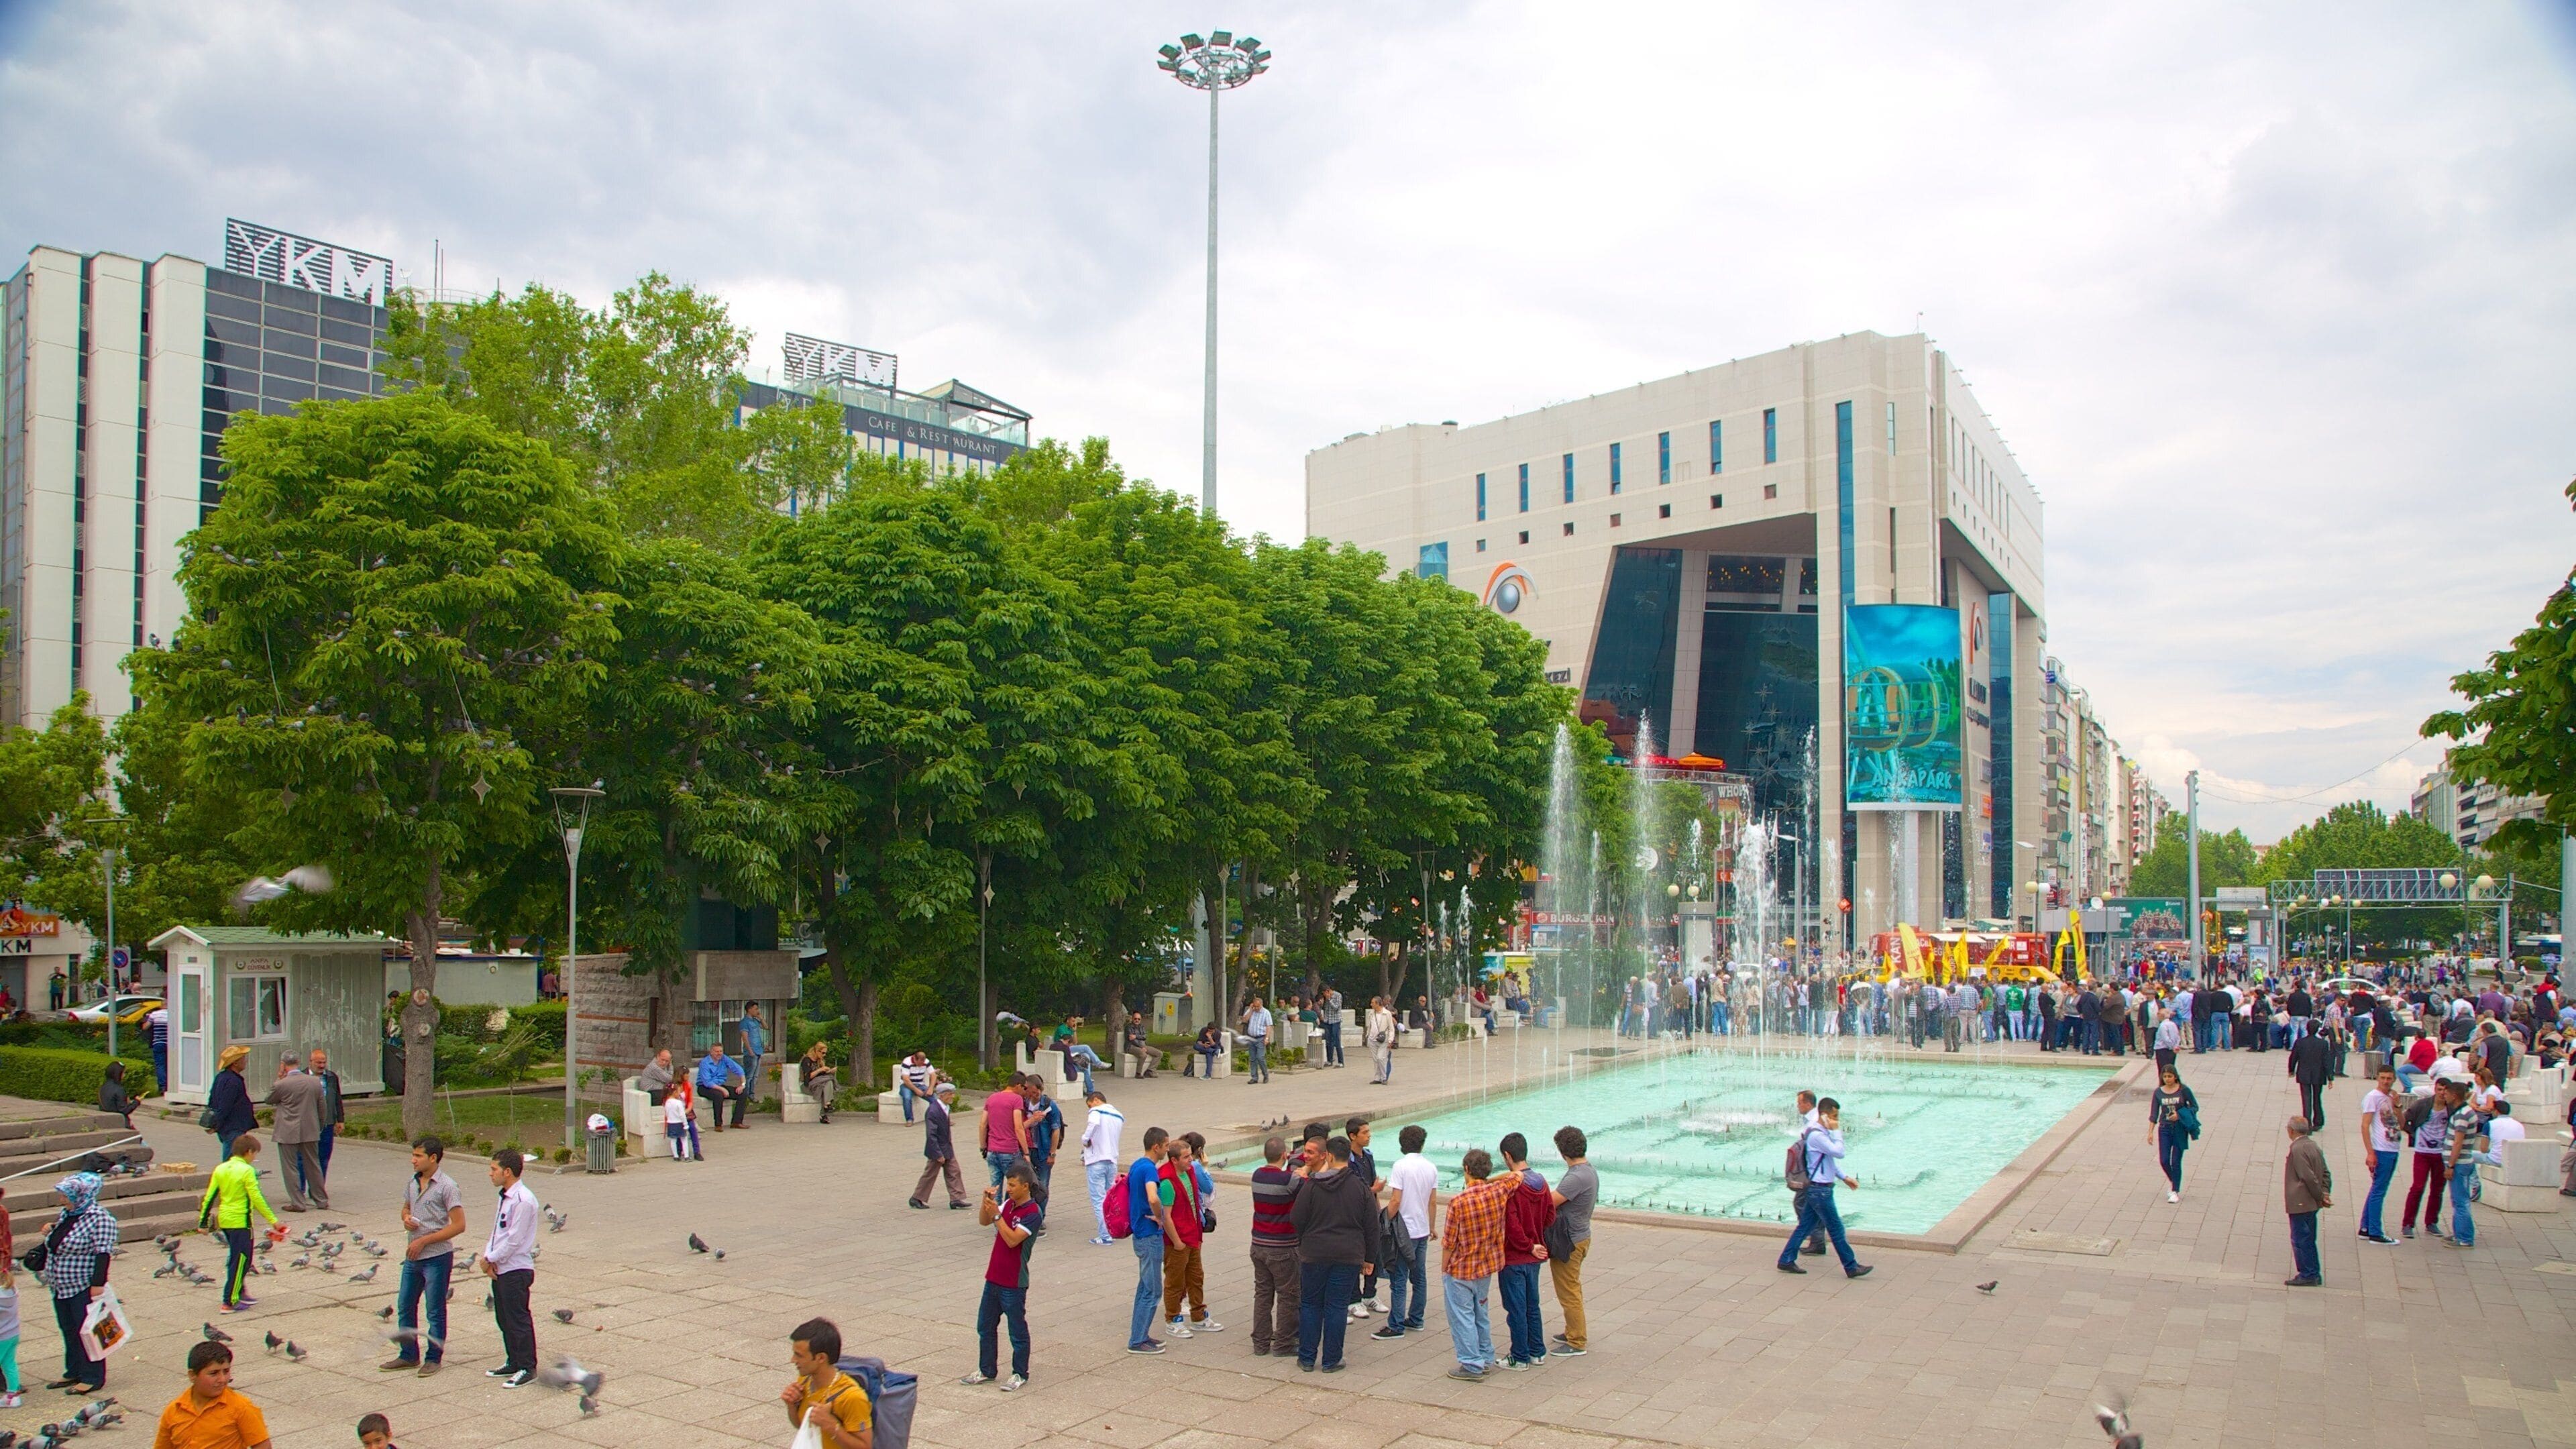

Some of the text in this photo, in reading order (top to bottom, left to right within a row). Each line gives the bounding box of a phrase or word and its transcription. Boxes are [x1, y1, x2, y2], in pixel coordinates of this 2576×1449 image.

[233, 222, 386, 308] YKM
[790, 337, 895, 387] YKM
[869, 416, 897, 433] CAFE
[907, 426, 916, 439] &
[1871, 767, 1953, 790] ANKAPARK
[21, 921, 54, 933] YKM
[1890, 937, 1901, 963] KAN
